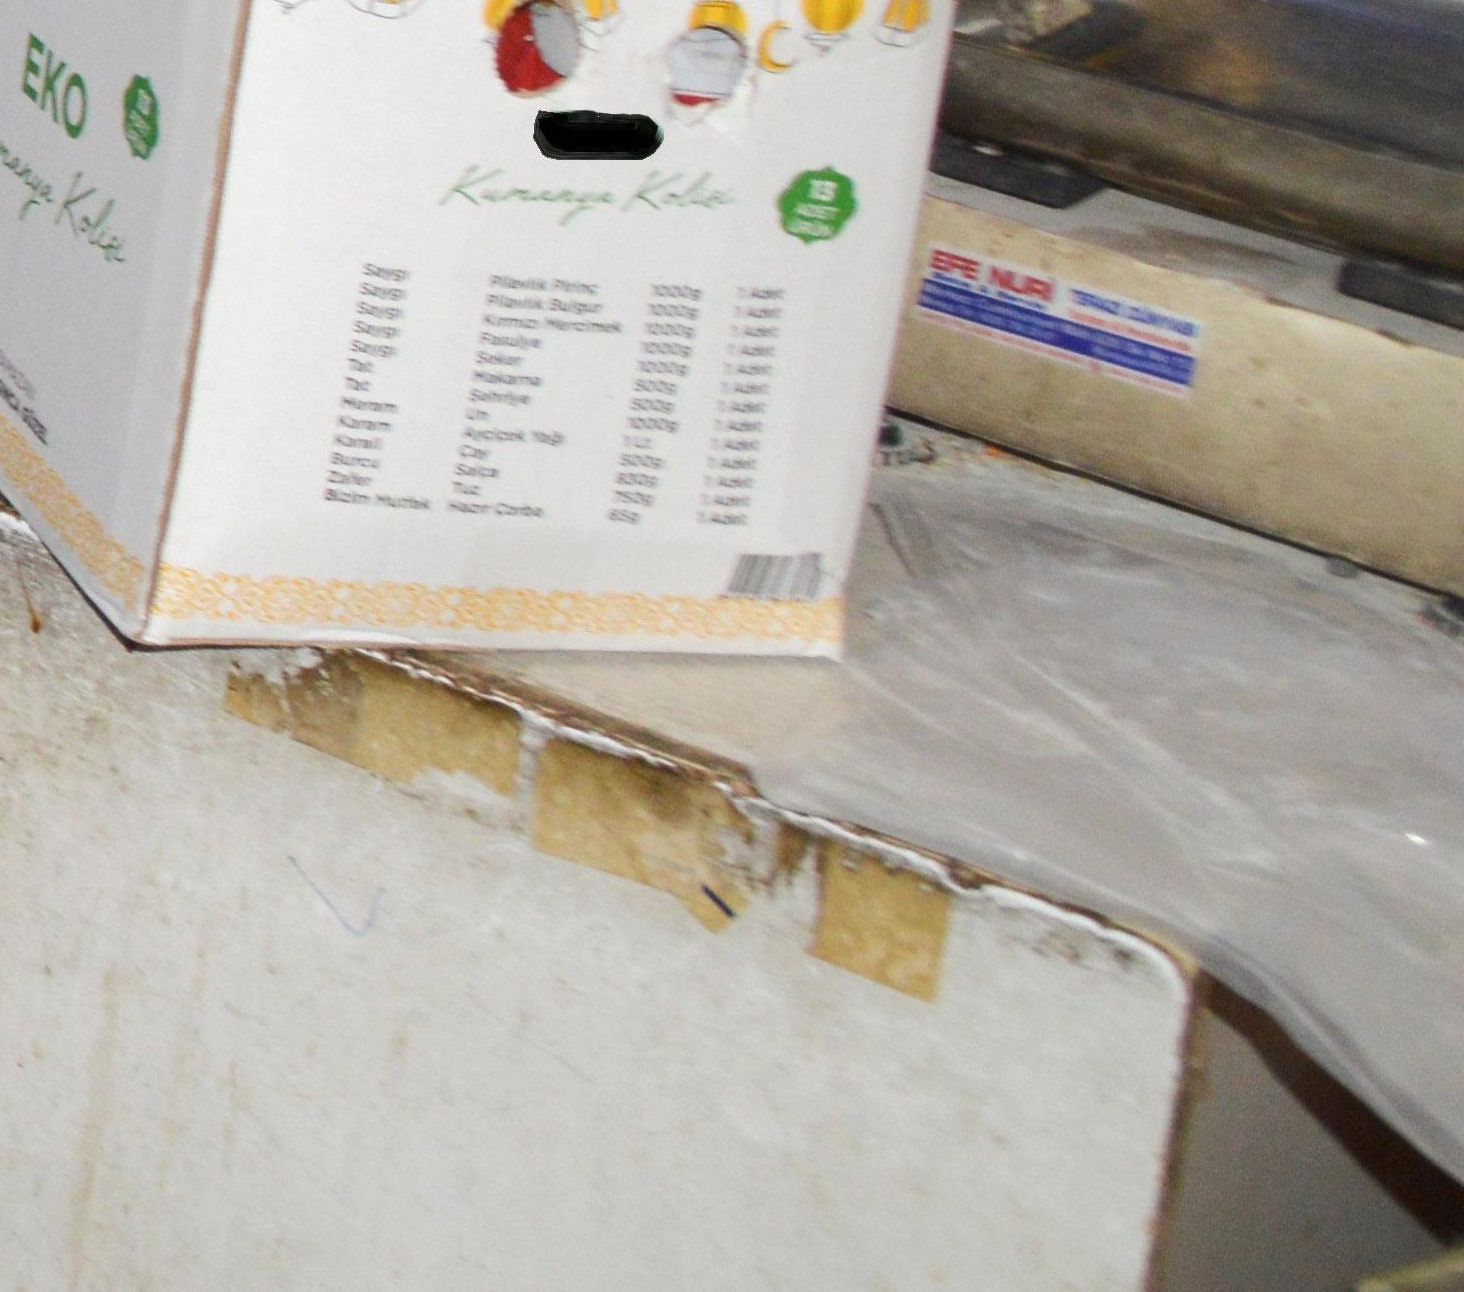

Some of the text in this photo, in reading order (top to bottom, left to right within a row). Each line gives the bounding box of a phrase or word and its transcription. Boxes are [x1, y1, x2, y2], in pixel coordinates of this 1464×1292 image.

[23, 32, 87, 139] EKO
[55, 170, 127, 263] Kolisi
[438, 164, 617, 228] Kumanya
[809, 178, 839, 201] 13
